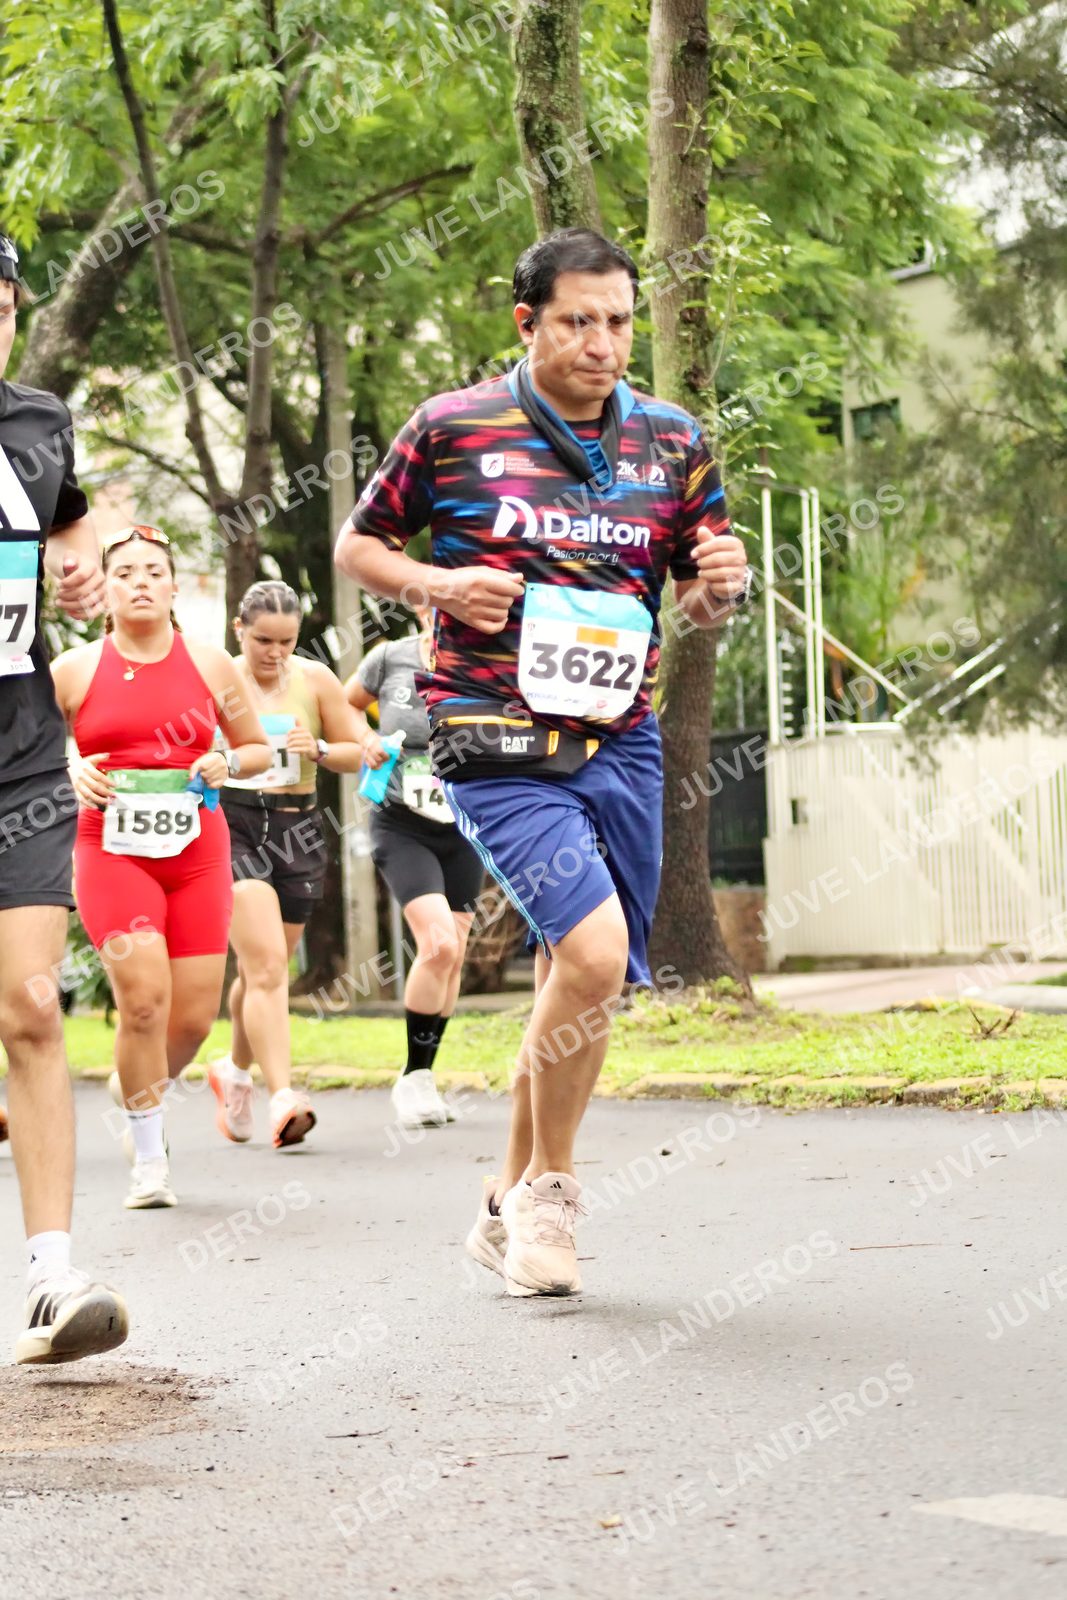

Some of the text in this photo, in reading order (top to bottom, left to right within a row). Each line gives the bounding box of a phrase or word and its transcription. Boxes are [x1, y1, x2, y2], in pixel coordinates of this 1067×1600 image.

[543, 510, 651, 549] Dalton
[546, 544, 621, 564] Pasión por ti
[527, 641, 638, 691] 3622
[116, 808, 194, 836] 1589
